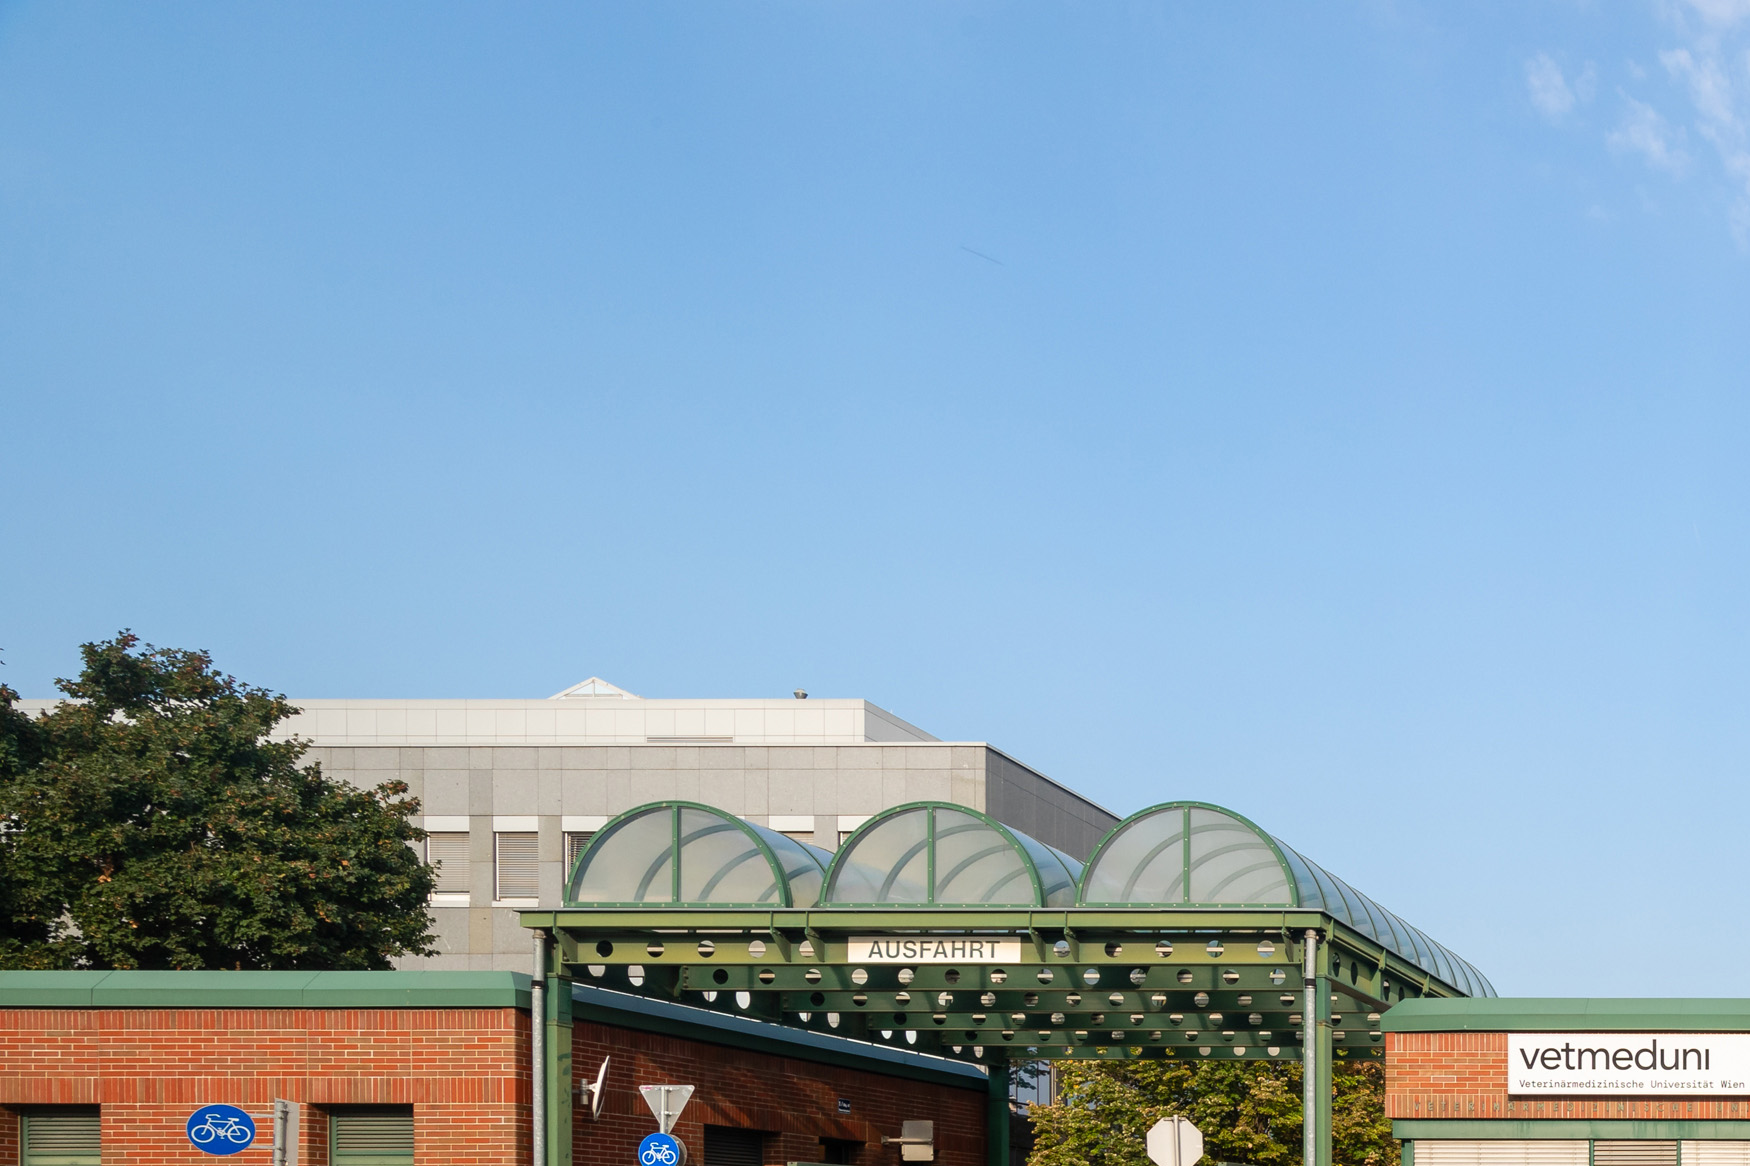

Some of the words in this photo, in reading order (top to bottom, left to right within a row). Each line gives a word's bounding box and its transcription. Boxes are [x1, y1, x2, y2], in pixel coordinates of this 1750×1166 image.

[868, 940, 1001, 959] AUSFAHRT
[1519, 1079, 1645, 1088] Veterinärmedizinische
[1650, 1079, 1714, 1088] Universität
[1720, 1079, 1745, 1088] Wien
[1414, 1100, 1693, 1112] VETERINÄRMEDIZINISCHE
